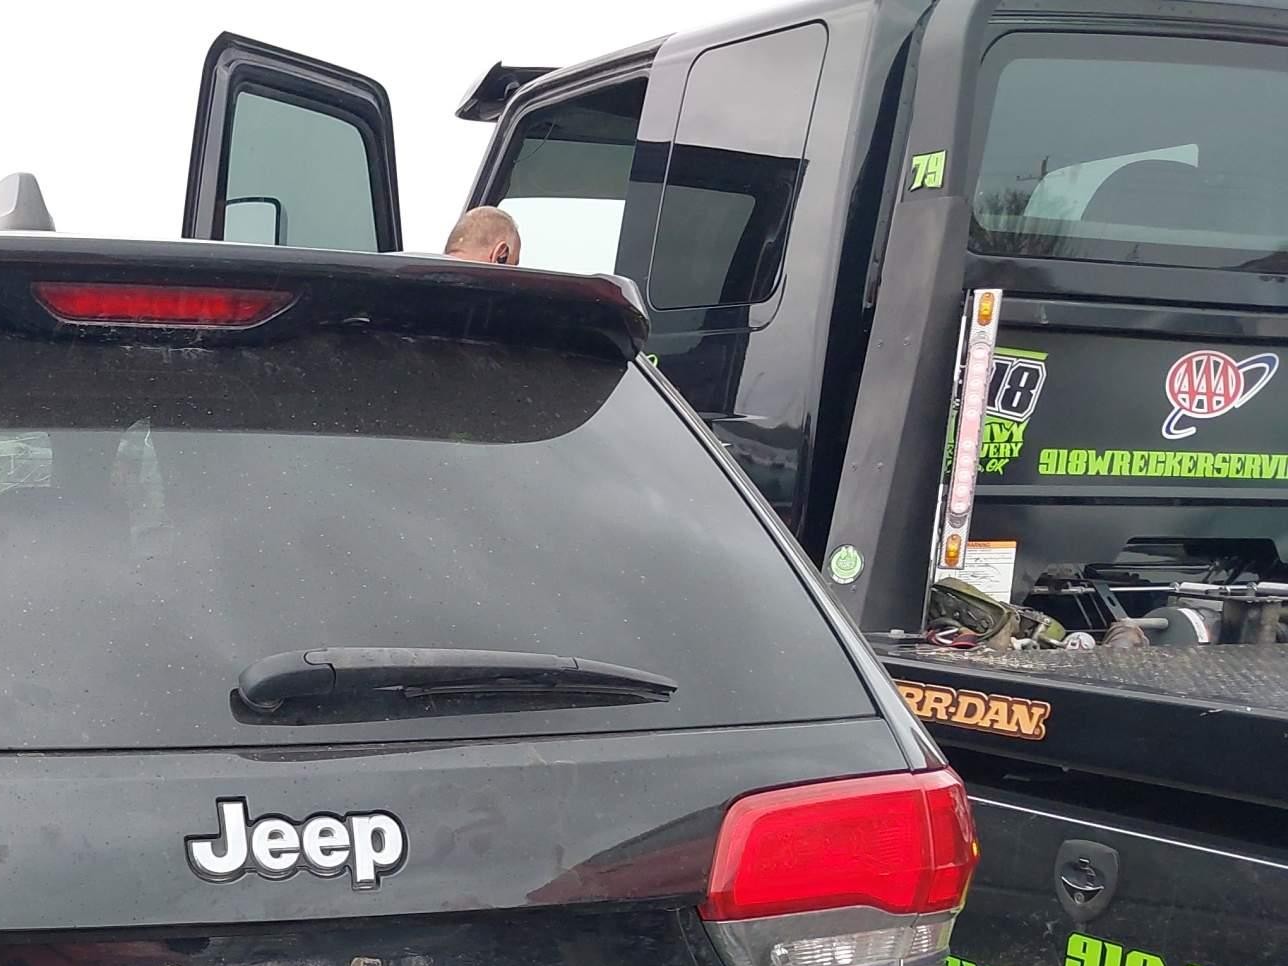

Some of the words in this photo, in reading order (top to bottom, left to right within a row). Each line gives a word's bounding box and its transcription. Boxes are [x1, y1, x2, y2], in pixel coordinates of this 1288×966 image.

[910, 150, 947, 191] 79
[985, 355, 1047, 422] 18
[1173, 354, 1236, 414] AAA
[980, 442, 1023, 458] VERY
[1038, 448, 1288, 480] 918WRECKERSERVI
[896, 684, 1045, 735] RR-DAN
[186, 797, 409, 890] Jeep
